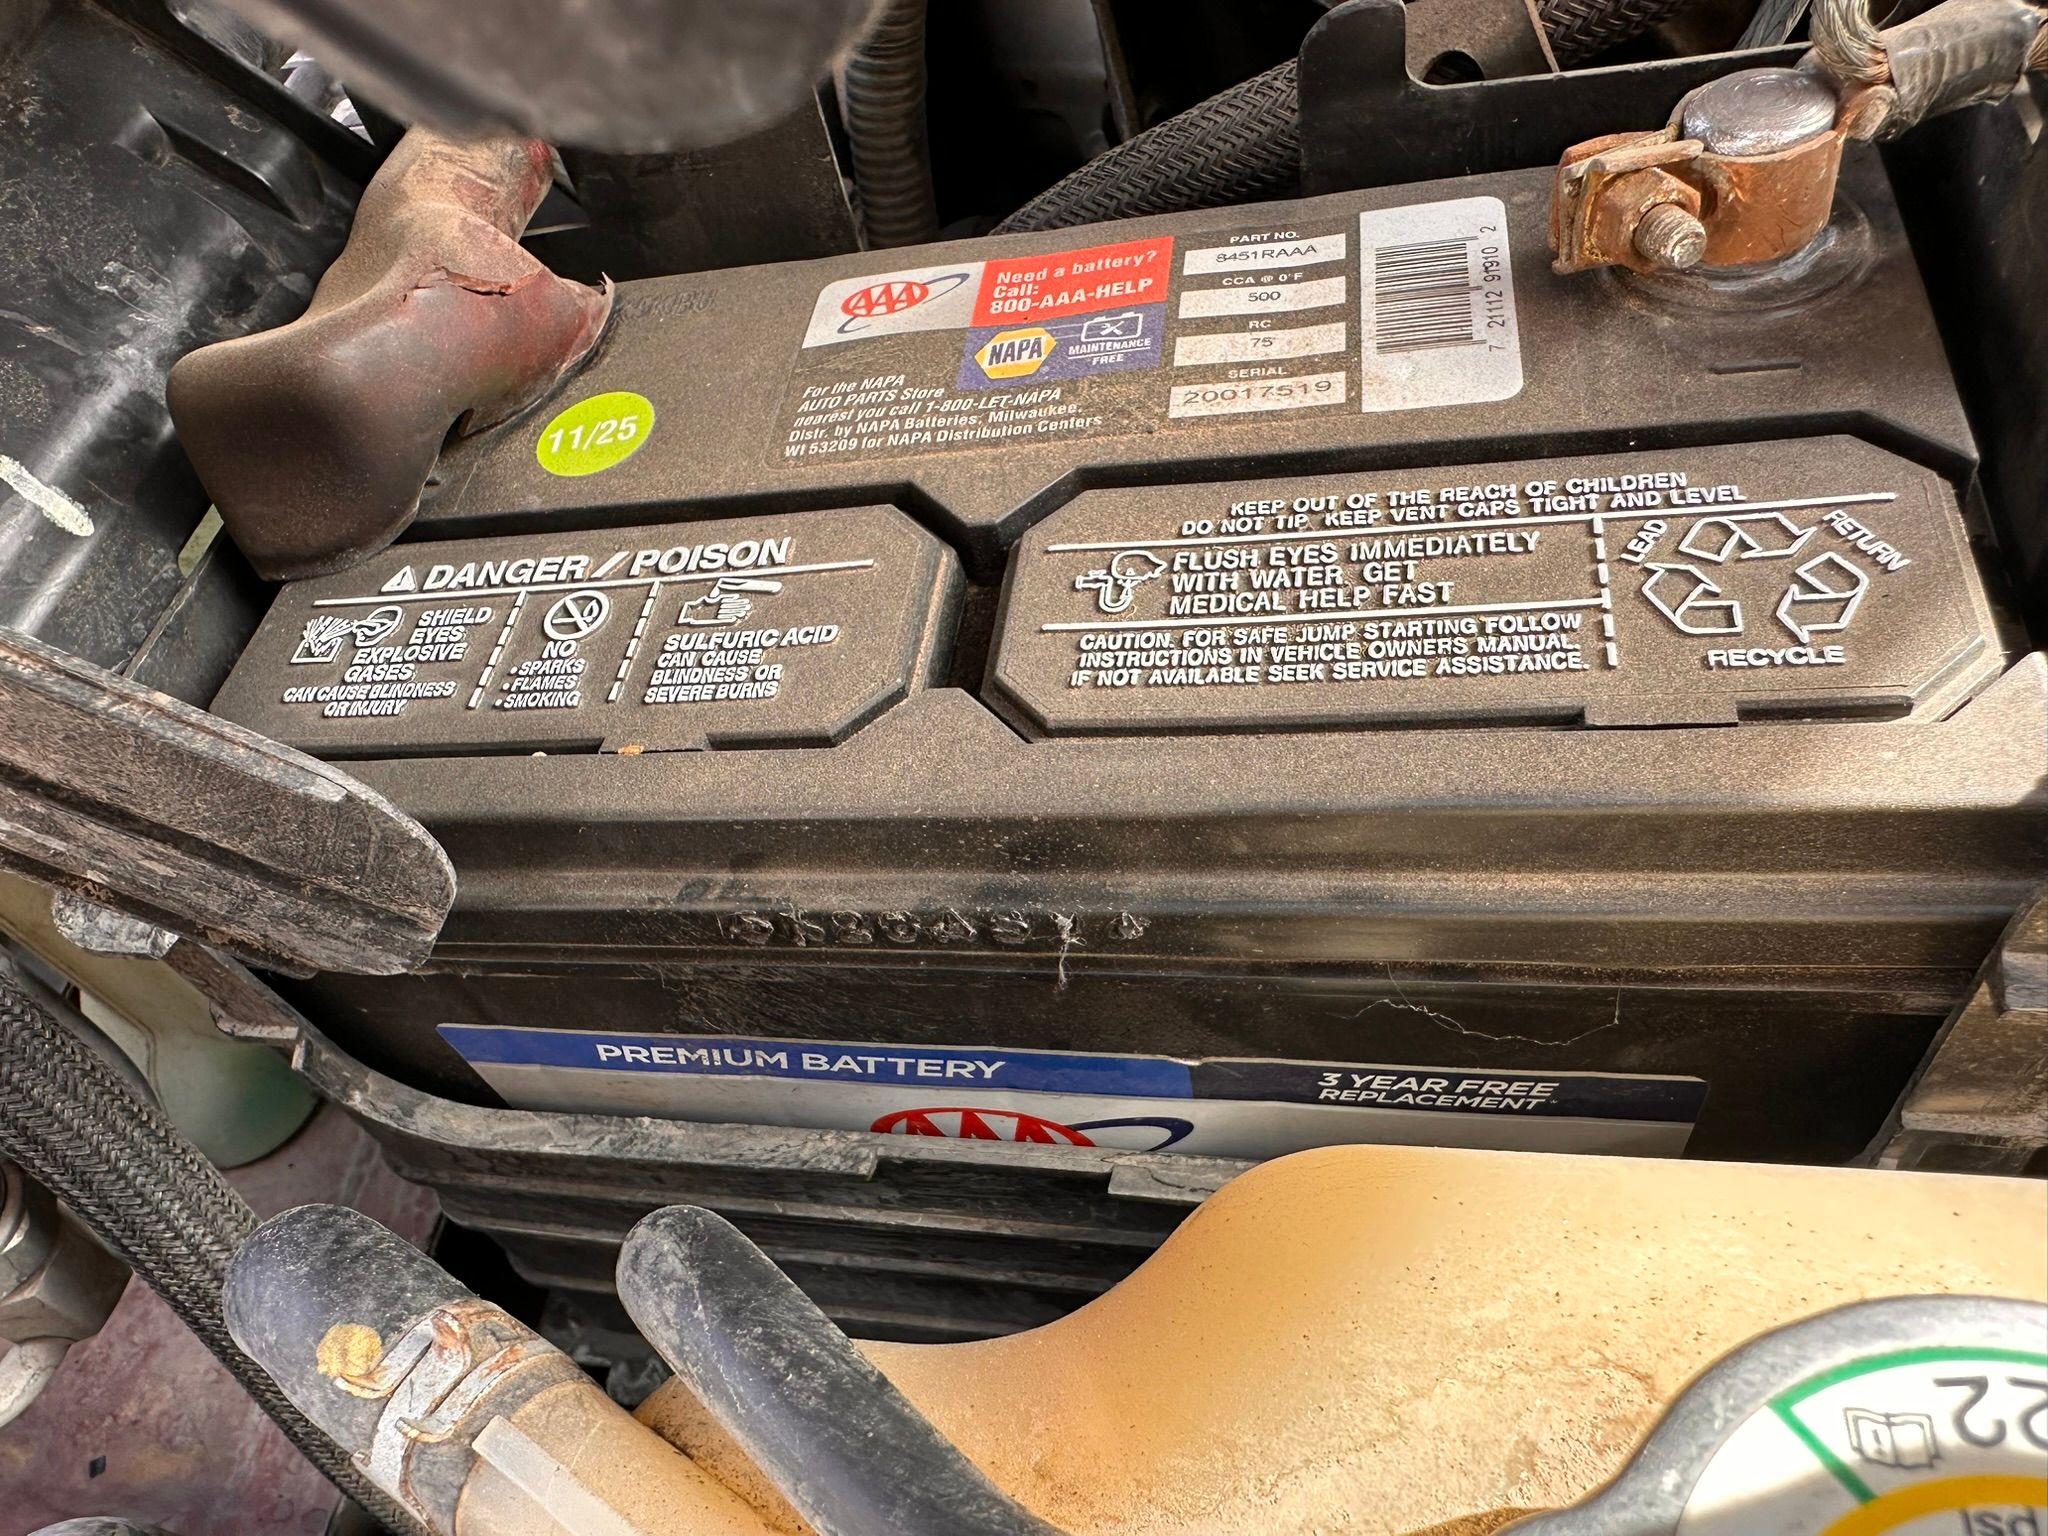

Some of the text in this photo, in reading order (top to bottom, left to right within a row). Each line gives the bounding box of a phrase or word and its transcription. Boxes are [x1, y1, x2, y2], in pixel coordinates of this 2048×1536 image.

[1230, 231, 1300, 244] PART NO.
[1480, 225, 1497, 234] 2
[996, 250, 1158, 285] Need a battery?
[993, 283, 1040, 299] Call:
[1222, 276, 1256, 286] CCA
[845, 282, 927, 316] AAA
[990, 278, 1154, 315] 800-AAA-HELP
[1248, 291, 1281, 302] 500
[1485, 289, 1505, 328] 21112
[1248, 319, 1272, 329] RC
[988, 336, 1042, 367] NAPA
[1068, 338, 1151, 355] MAINTENANCE
[1251, 337, 1273, 348] 75
[1489, 344, 1503, 352] 7
[1092, 354, 1124, 365] FREE
[1228, 366, 1288, 379] SERIAL
[802, 374, 905, 399] For the NAPA
[1183, 380, 1332, 405] 20017519
[793, 387, 1062, 427] nearest you call 1-800-LET-NAPA
[797, 387, 945, 413] AUTO PARTS Store
[549, 415, 639, 454] 11/25
[785, 416, 1102, 457] WI 53209 for NAPA Distribution Centers
[789, 428, 829, 442] Distr.
[834, 425, 852, 438] by
[856, 418, 900, 434] NAPA
[1231, 472, 1688, 516] KEEP OUT OF THE REACH OF CHILDREN
[1182, 519, 1213, 536] DO
[1220, 517, 1265, 534] NOT
[1324, 511, 1383, 527] KEEP
[1391, 505, 1449, 523] VENT
[1458, 501, 1520, 518] CAPS
[1529, 494, 1600, 514] TIGHT
[1610, 492, 1662, 508] AND
[1670, 485, 1747, 505] LEVEL
[1173, 531, 1540, 572] FLUSH EYES IMMEDIATELY
[1620, 519, 1669, 563] LEAD
[1823, 509, 1911, 571] RETURN
[1171, 572, 1238, 593] WITH
[1363, 560, 1419, 583] GET
[1169, 582, 1455, 615] MEDICAL HELP FAST
[418, 607, 493, 626] SHIELD
[409, 626, 466, 645] EYES
[664, 625, 839, 651] SULFURIC ACID
[1182, 629, 1227, 647] FOR
[1233, 627, 1288, 645] SAFE
[1295, 624, 1356, 643] JUMP
[1363, 617, 1478, 640] STARTING
[1485, 613, 1582, 634] FOLLOW
[352, 643, 468, 665] EXPLOSIVE
[542, 640, 577, 658] NO
[657, 649, 762, 668] CAN CAUSE
[1079, 633, 1581, 668] INSTRUCTIONS IN VEHICLE OWNERS MANUAL.
[1707, 646, 1846, 667] RECYCLE
[344, 664, 415, 683] GASES
[651, 665, 782, 685] BLINDNESS OR
[1070, 652, 1590, 687] IF NOT AVAILABLE SEEK SERVICE ASSISTANCE.
[283, 681, 456, 702] CAN CAUSE BLINDNESS
[645, 681, 779, 703] SEVERE BURNS
[324, 699, 406, 717] OR INJURY
[595, 1043, 1007, 1079] PREMIUM BATTERY
[1317, 1071, 1560, 1098] 3 YEAR FREE
